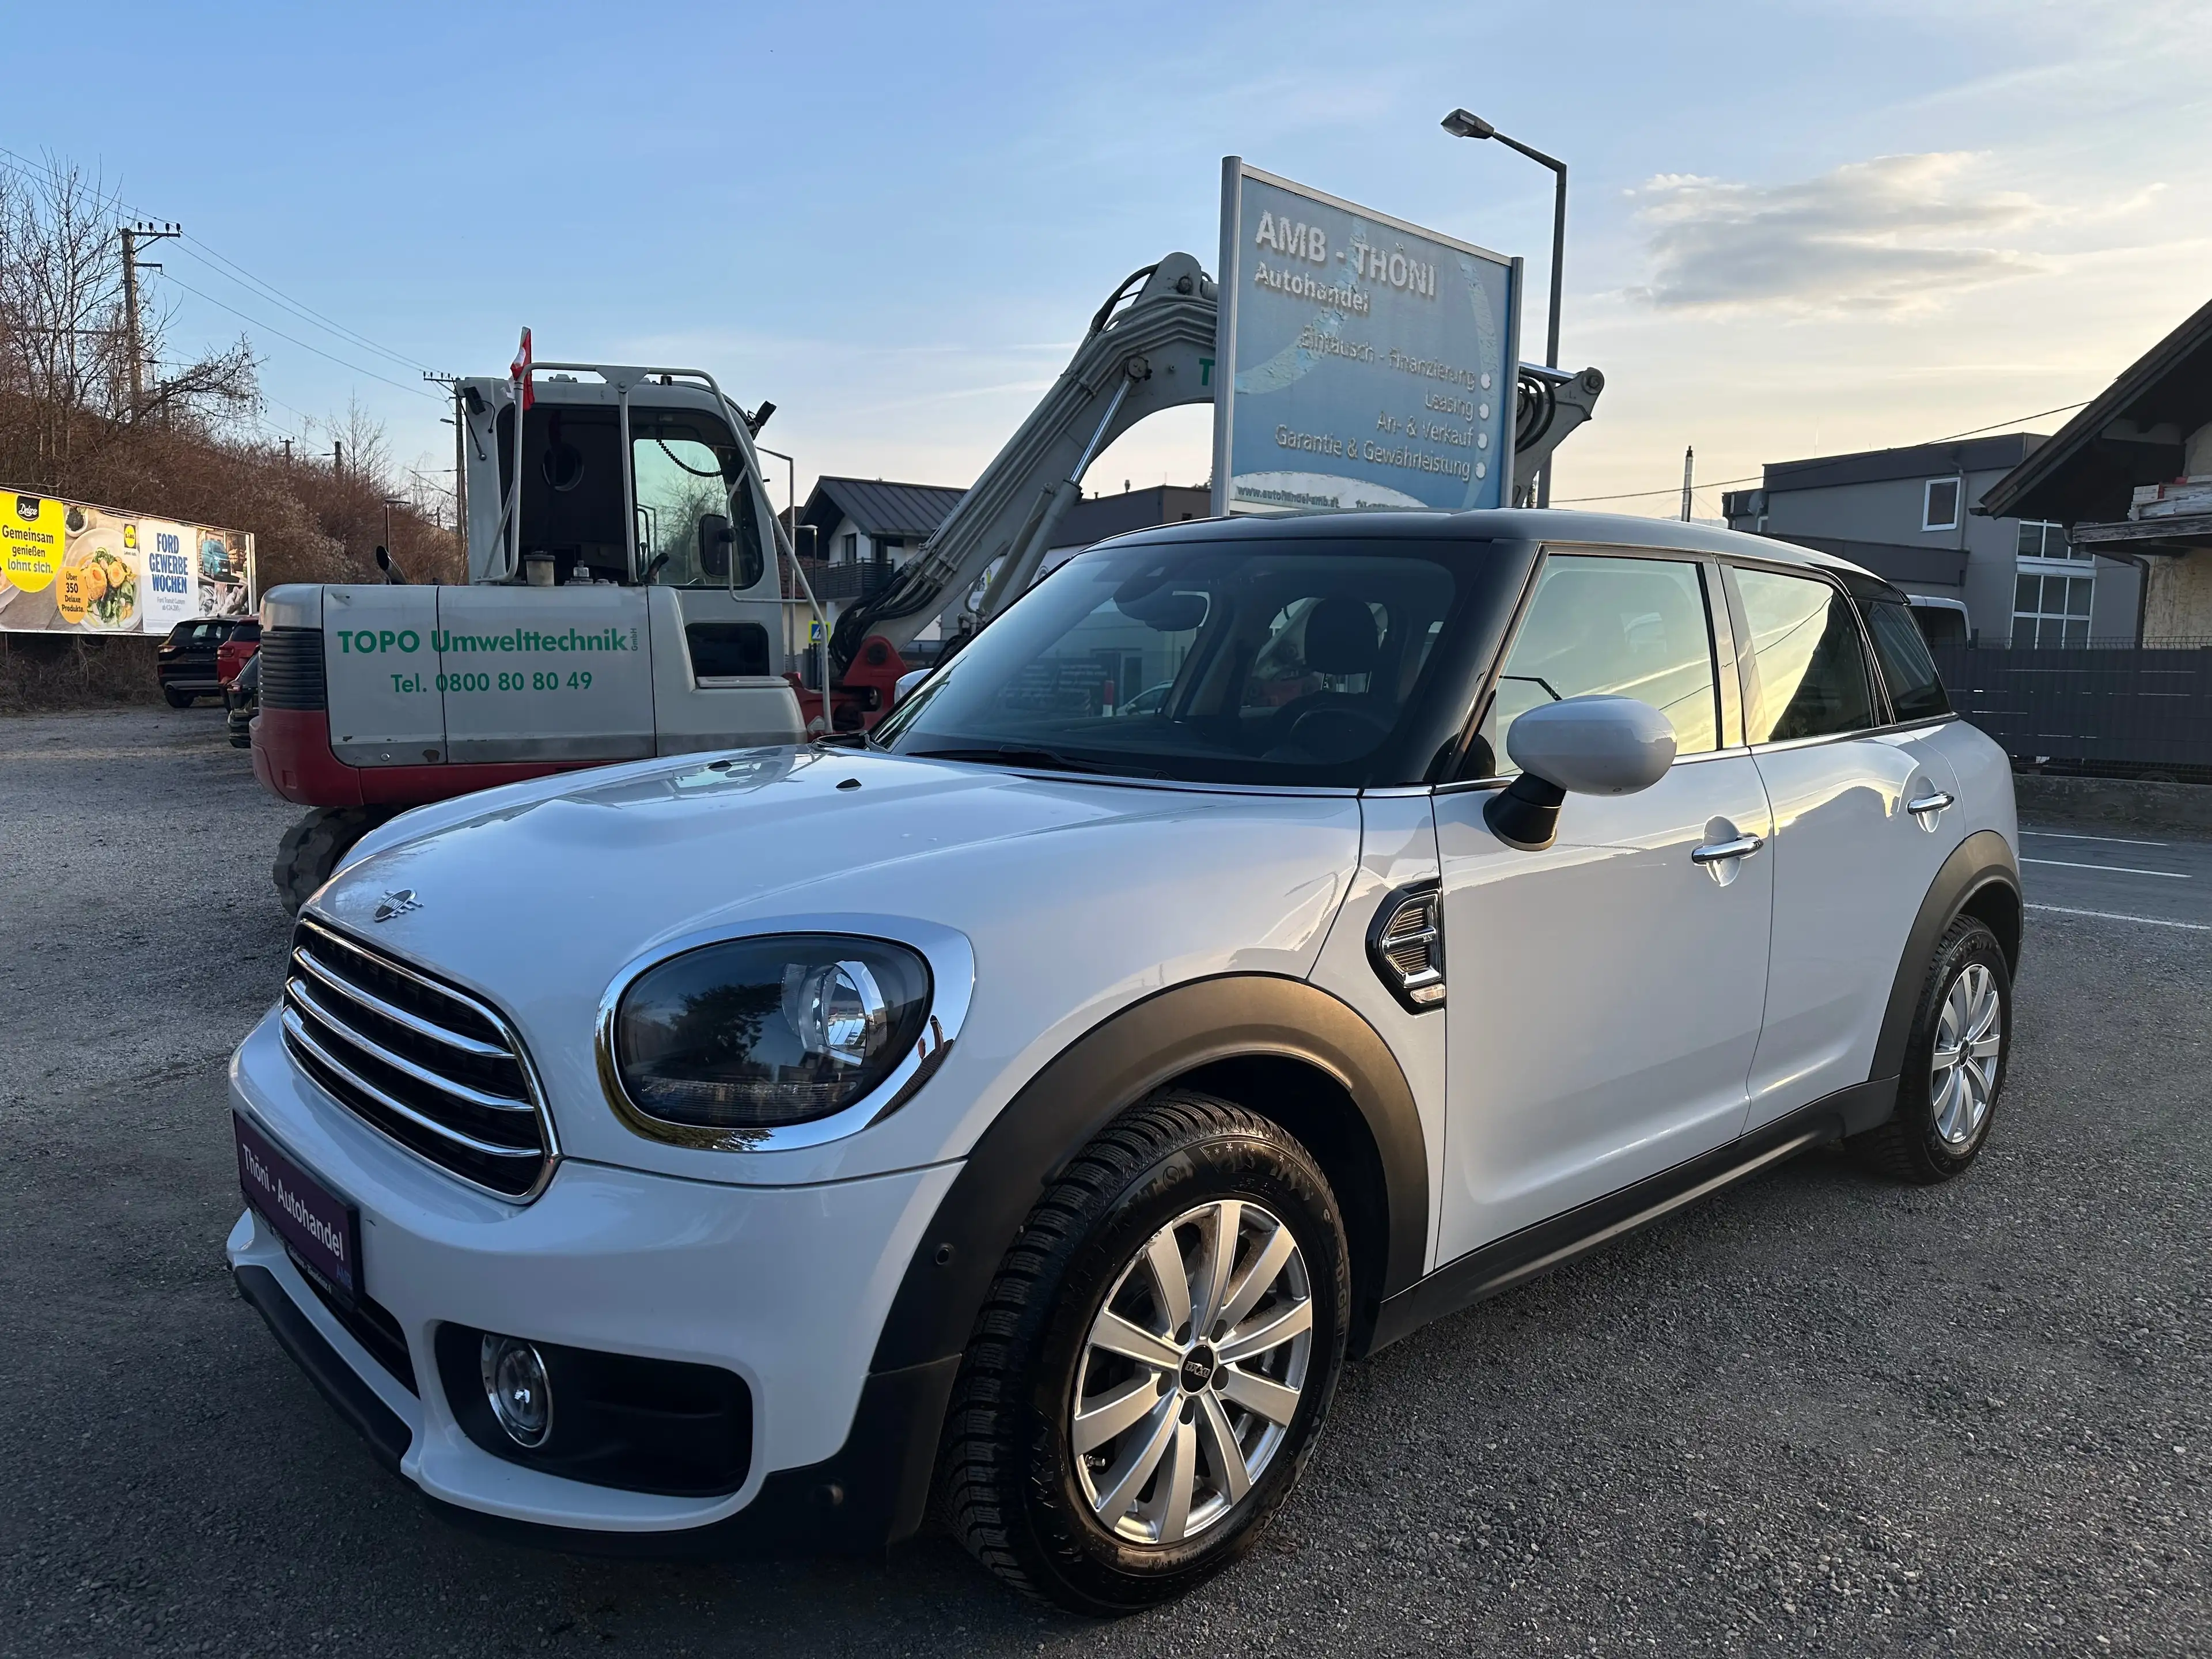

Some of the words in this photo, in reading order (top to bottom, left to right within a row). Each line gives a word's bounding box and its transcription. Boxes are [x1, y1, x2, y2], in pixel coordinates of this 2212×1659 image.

[1256, 210, 1325, 262] AMB
[1354, 243, 1435, 296] THÖNI
[1255, 261, 1369, 312] Autohandel
[1297, 325, 1375, 364] Eintausch
[1389, 347, 1475, 392] Finanzierung
[1425, 388, 1474, 422] Leasing
[1377, 411, 1402, 434] An-
[1407, 416, 1417, 437] &
[1423, 420, 1474, 447] Verkauf
[1275, 424, 1343, 456] Garantie
[1347, 438, 1358, 459] &
[1364, 440, 1471, 482] Gewährleistung
[2, 525, 54, 544] Gemeinsam
[157, 533, 179, 554] FORD
[12, 544, 46, 557] genießen
[8, 558, 31, 571] lohnt
[33, 561, 53, 574] sich.
[149, 553, 188, 575] GEWERBE
[66, 582, 78, 593] 350
[152, 574, 187, 594] WOCHEN
[338, 630, 419, 653] TOPO
[431, 628, 628, 652] Umwelttechnik
[391, 673, 427, 692] Tel.
[435, 672, 490, 691] 0800
[498, 672, 525, 691] 80
[532, 672, 559, 690] 80
[567, 672, 592, 690] 49
[243, 1143, 270, 1192] Thöni
[278, 1179, 344, 1260] Autohandel
